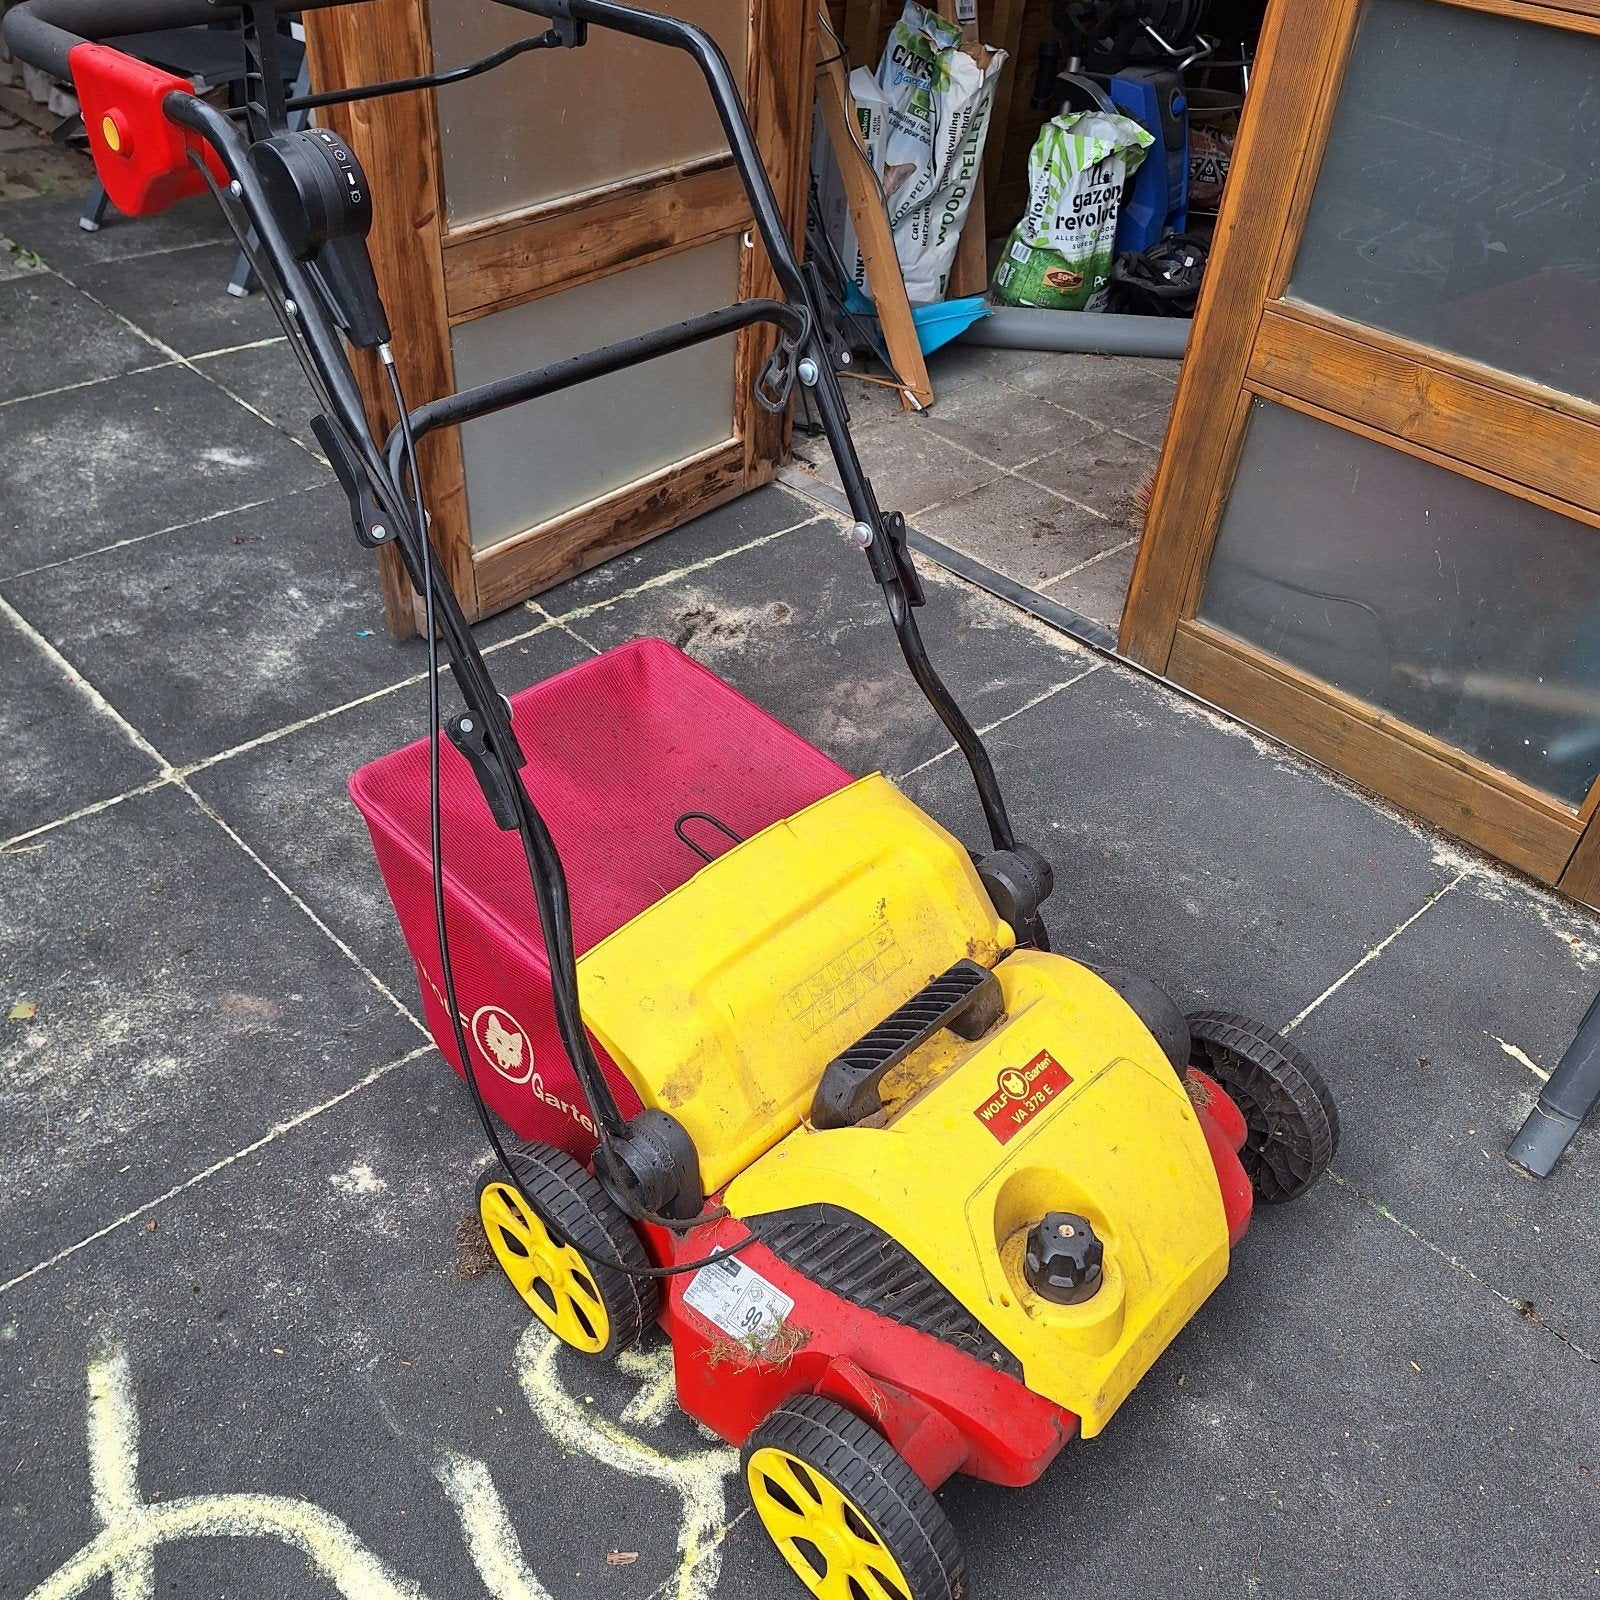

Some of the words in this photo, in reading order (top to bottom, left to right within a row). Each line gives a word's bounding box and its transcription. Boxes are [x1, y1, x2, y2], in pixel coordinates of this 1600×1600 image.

[904, 127, 919, 139] pour
[1072, 185, 1120, 214] gazon
[936, 186, 967, 247] WOOD
[911, 225, 920, 241] Cat
[980, 1094, 1009, 1121] WOLF
[1024, 1057, 1053, 1082] Garten
[1011, 1108, 1029, 1124] VA
[1024, 1091, 1046, 1112] 378
[1042, 1083, 1055, 1096] E
[740, 1306, 763, 1332] 99
